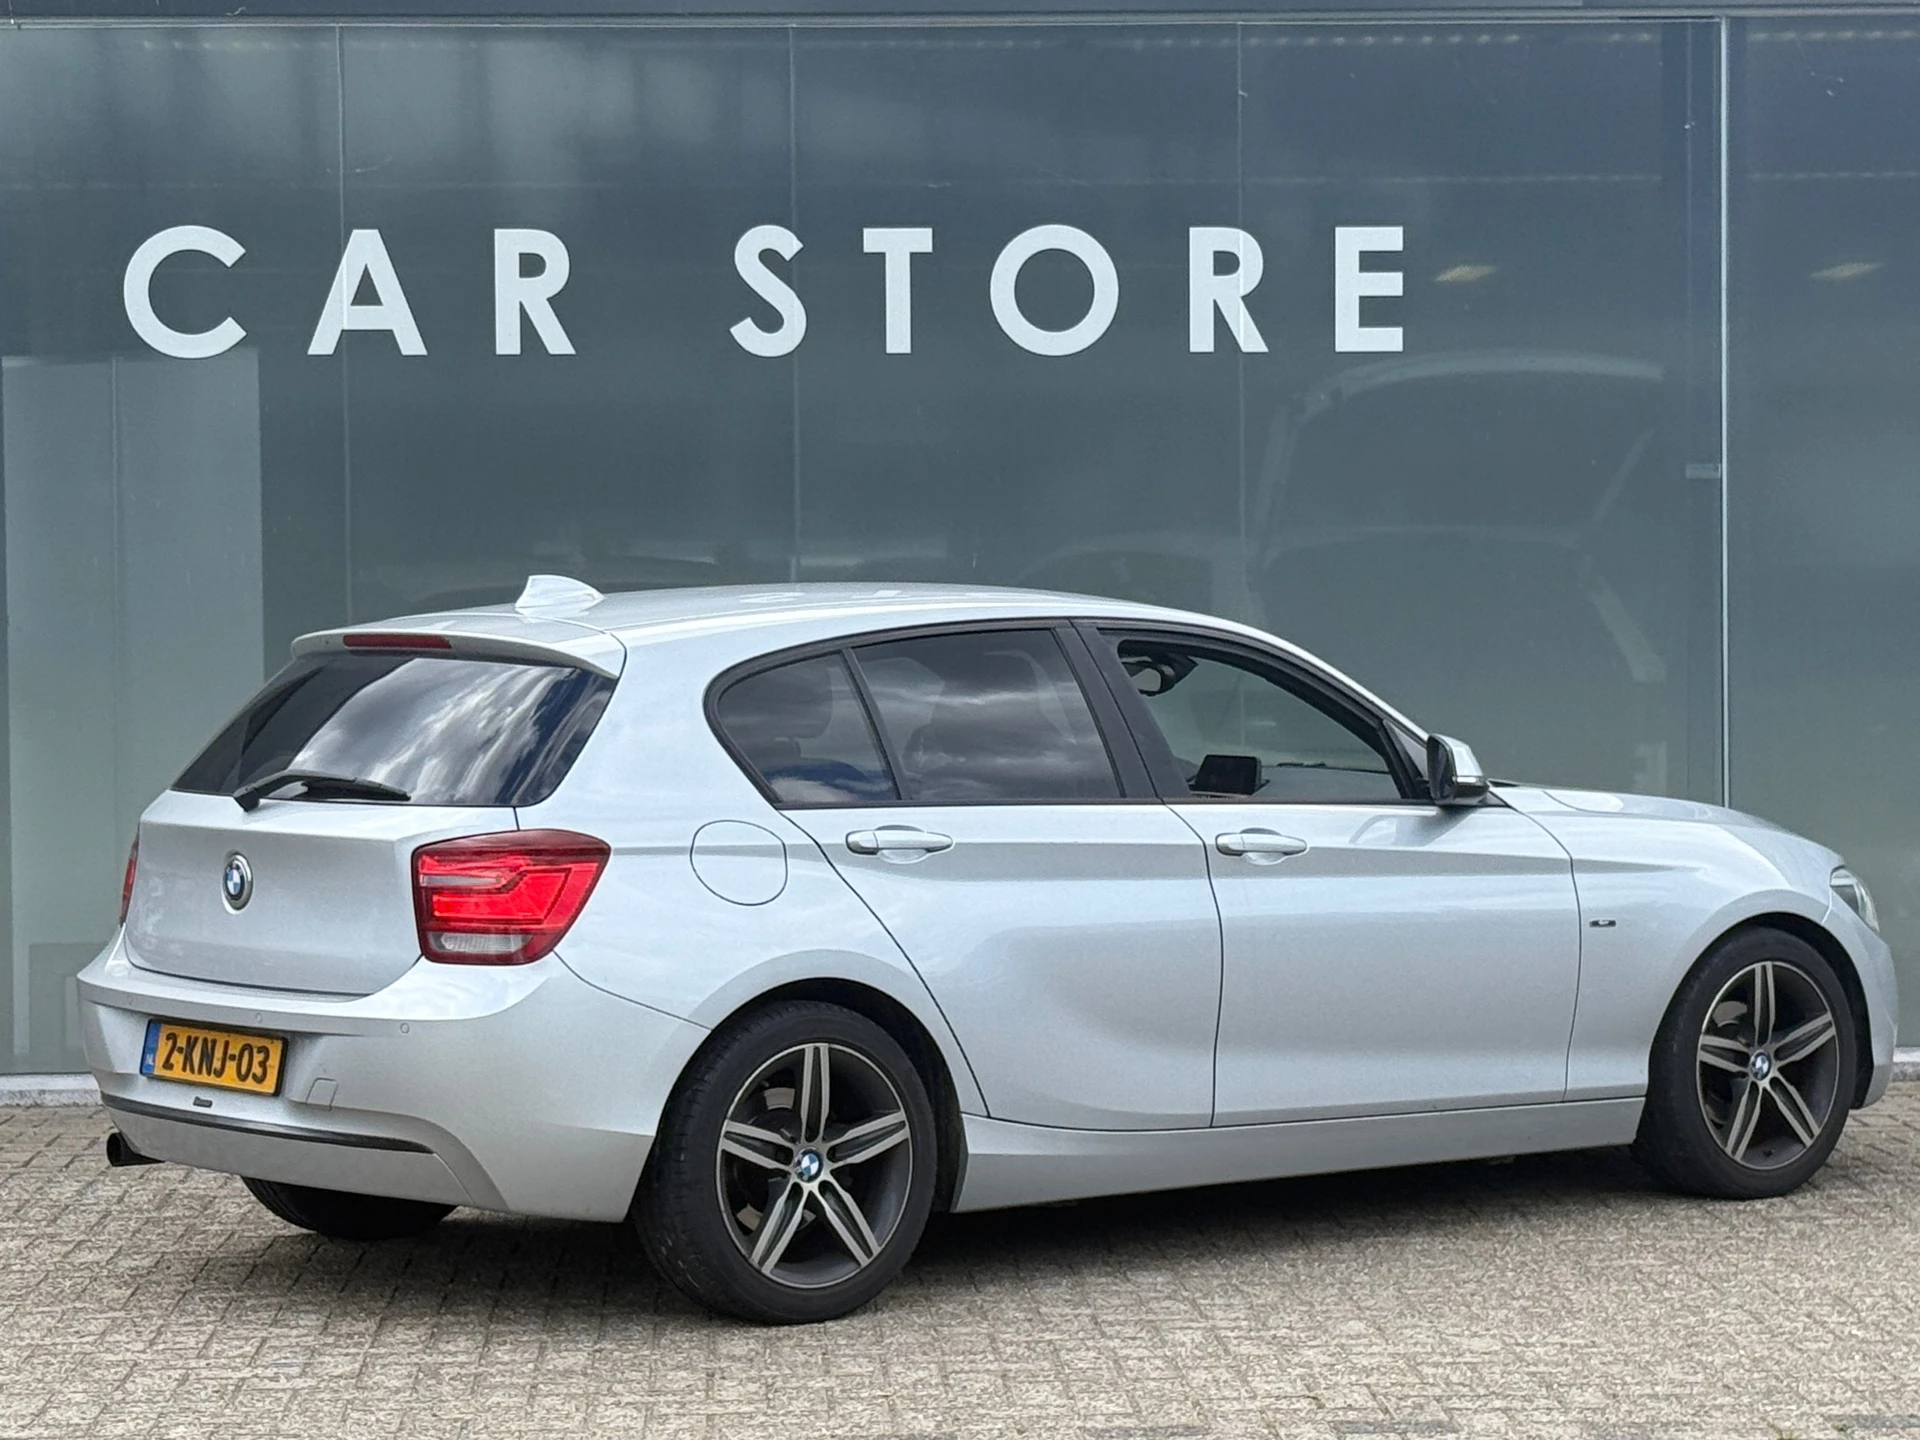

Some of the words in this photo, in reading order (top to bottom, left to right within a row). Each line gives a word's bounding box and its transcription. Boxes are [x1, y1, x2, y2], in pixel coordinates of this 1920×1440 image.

[123, 225, 576, 358] CAR
[729, 224, 1404, 357] STORE
[161, 1032, 270, 1084] 2-KNJ-03
